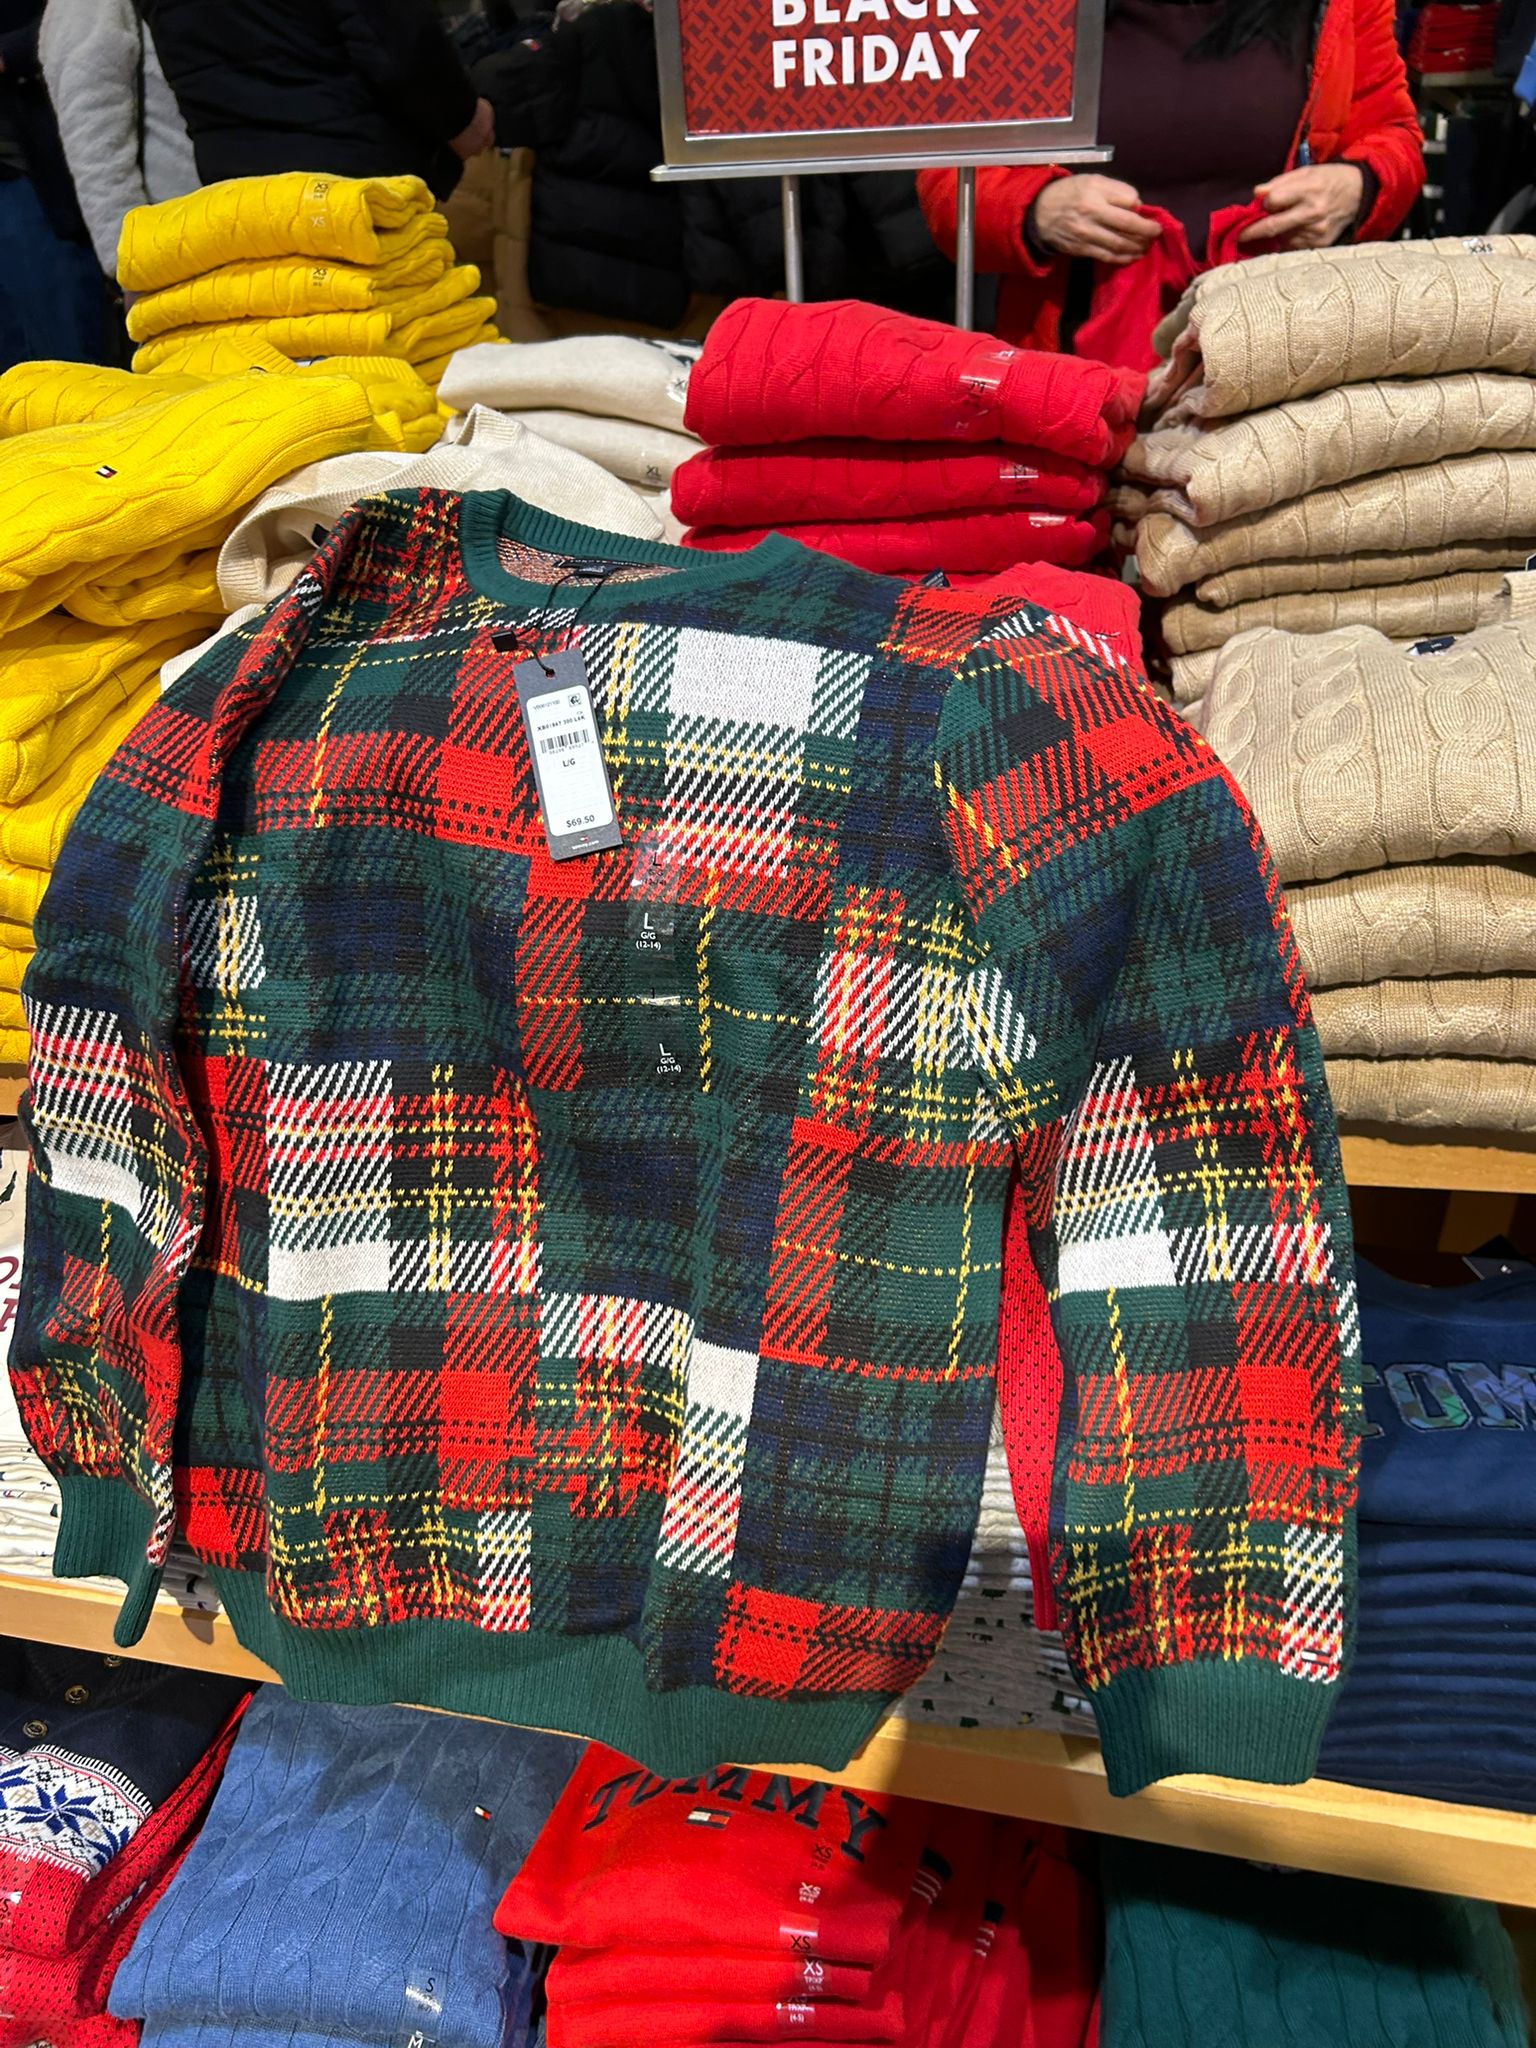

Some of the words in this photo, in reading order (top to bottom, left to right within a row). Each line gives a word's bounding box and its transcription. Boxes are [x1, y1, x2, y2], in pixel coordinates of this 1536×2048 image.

[772, 28, 981, 89] FRIDAY
[310, 215, 326, 227] XS
[312, 267, 328, 278] XS
[562, 757, 576, 767] L/G
[566, 814, 595, 828] $69.50
[652, 851, 662, 867] L
[643, 912, 655, 930] L
[640, 931, 657, 940] G/G
[635, 940, 662, 950] (12-14)
[659, 1042, 672, 1056] L
[660, 1057, 676, 1065] G/G
[656, 1064, 682, 1075] (12-14)
[1361, 1361, 1536, 1439] OM
[813, 1843, 833, 1860] XS
[800, 1881, 822, 1898] XS
[790, 1934, 812, 1951] XS
[803, 1959, 824, 1976] XS
[425, 1977, 436, 1993] S
[407, 2034, 424, 2048] M
